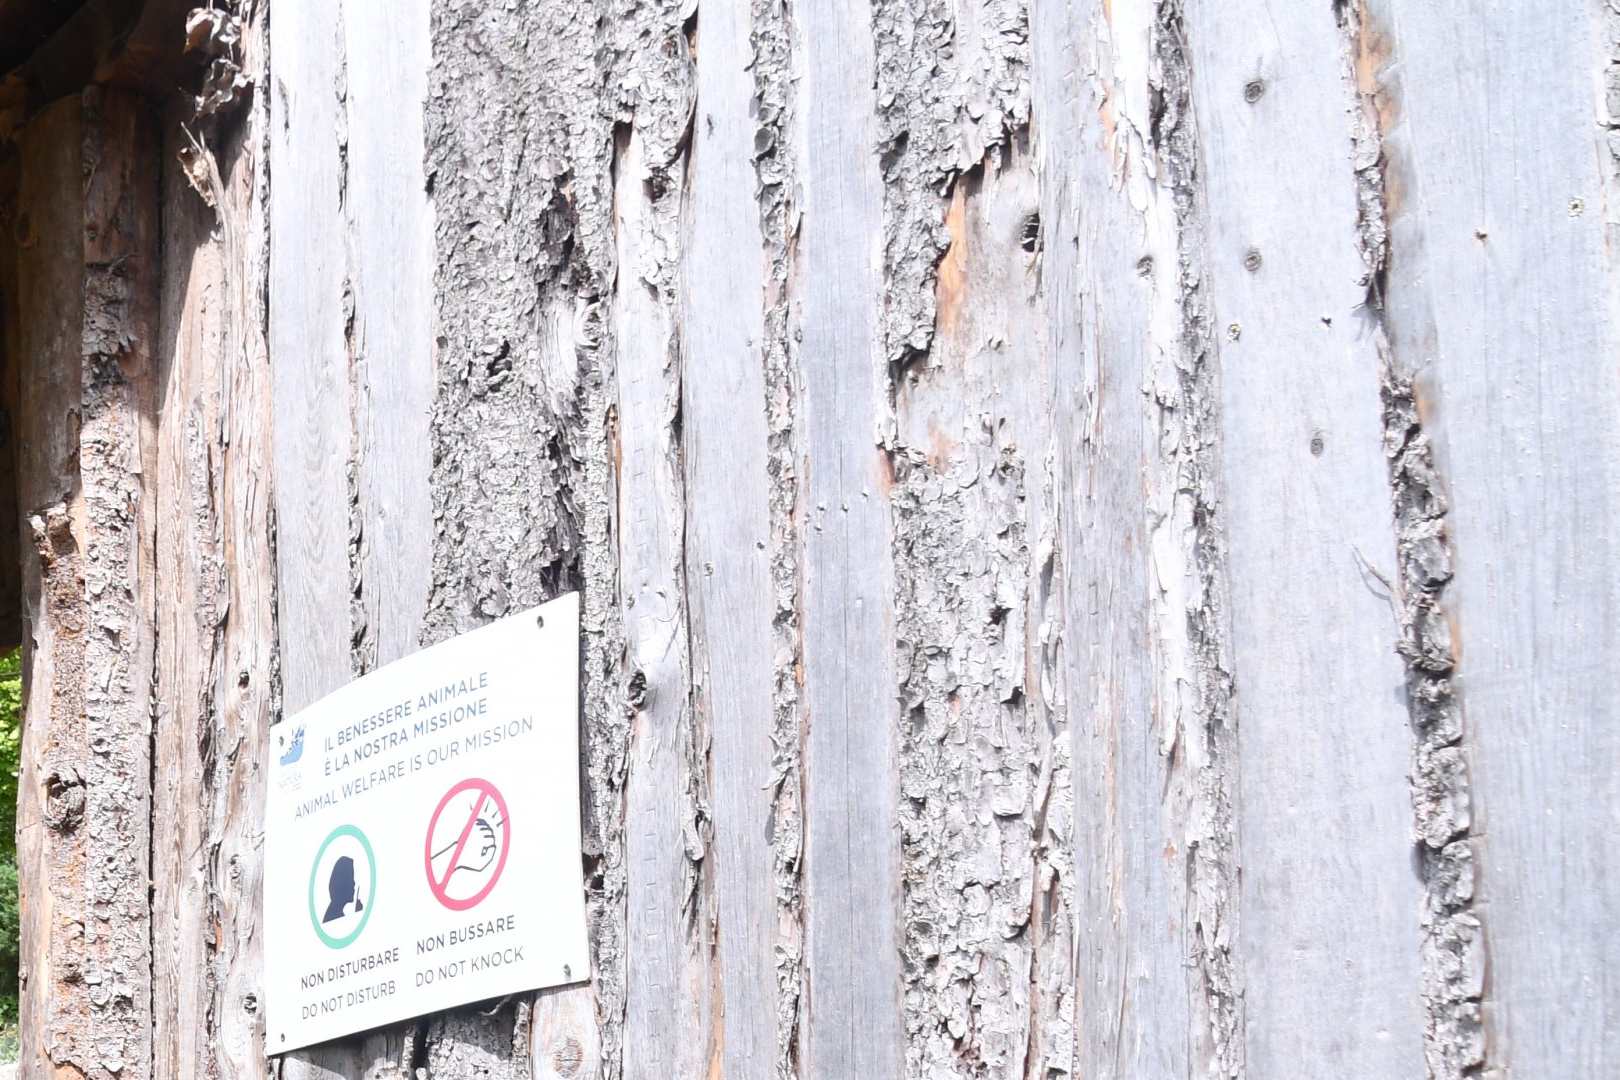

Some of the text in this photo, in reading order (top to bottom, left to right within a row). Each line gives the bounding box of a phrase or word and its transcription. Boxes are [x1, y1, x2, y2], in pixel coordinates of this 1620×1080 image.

[324, 672, 488, 753] IL BENESSERE ANIMALE
[325, 698, 487, 776] È LA NOSTRA MISSIONE
[294, 716, 533, 821] ANIMAL WELFARE IS OUR MISSION
[417, 915, 515, 955] NON BUSSARE
[301, 948, 399, 990] NON DISTURBARE
[415, 946, 524, 987] DO NOT KNOCK
[302, 980, 396, 1019] DO NOT DISTURB
